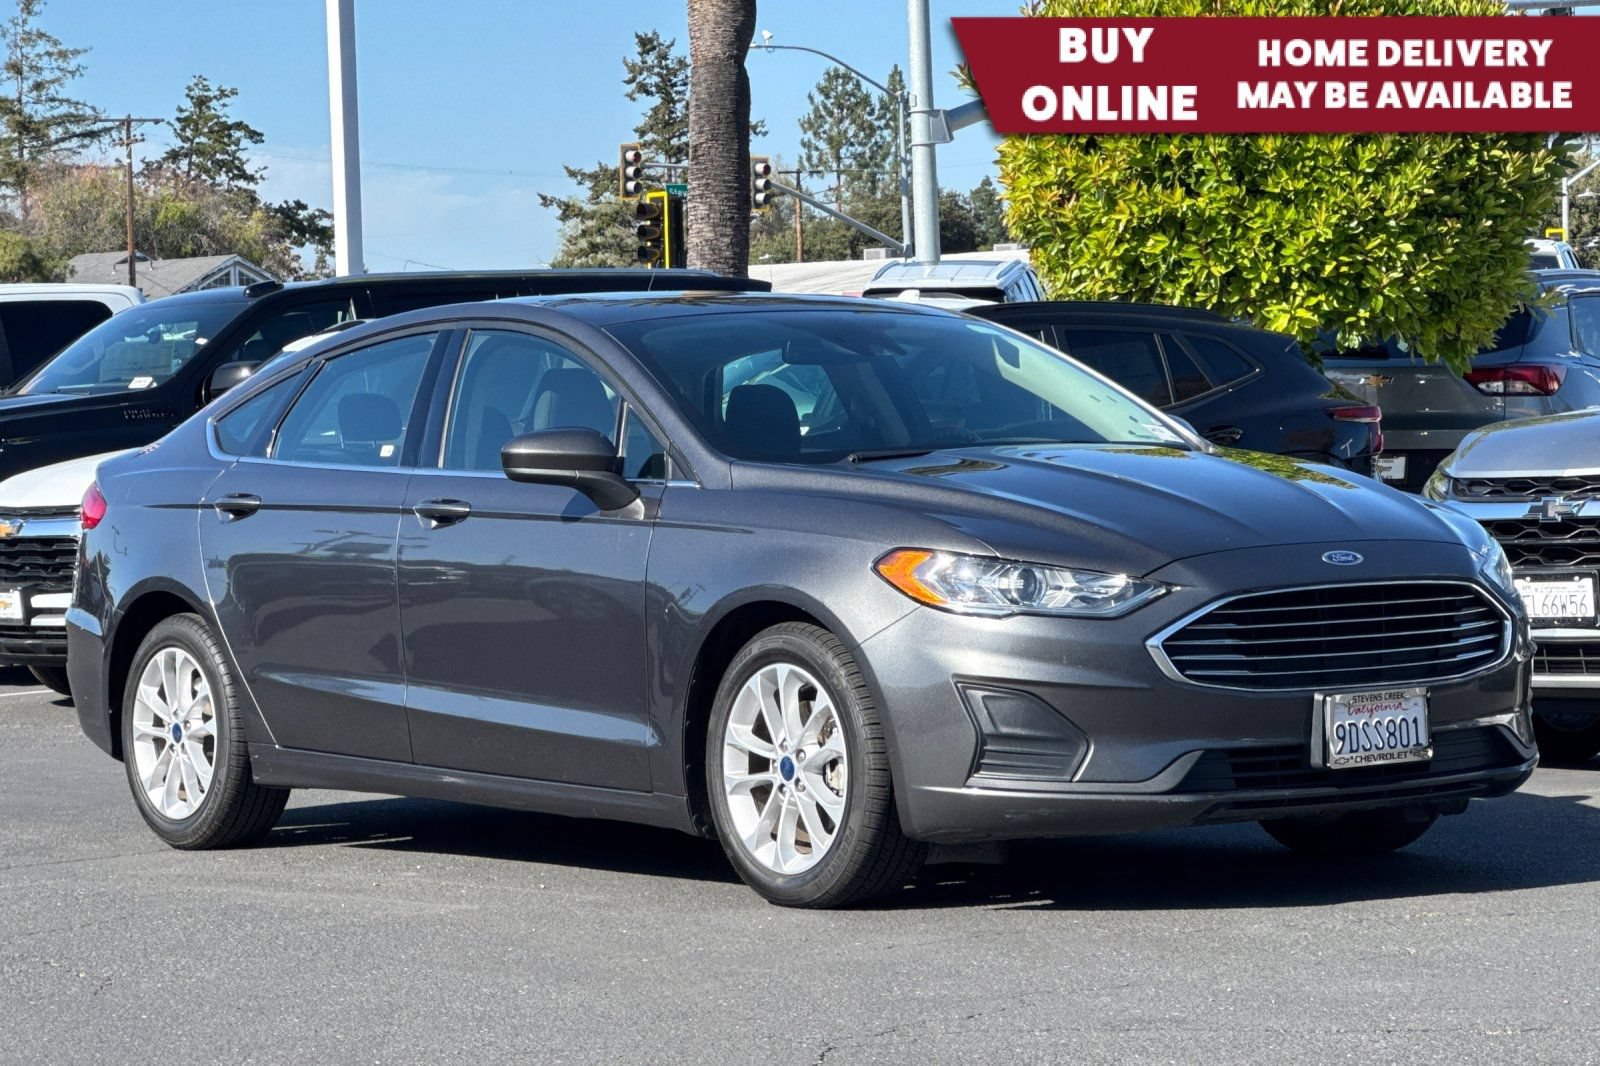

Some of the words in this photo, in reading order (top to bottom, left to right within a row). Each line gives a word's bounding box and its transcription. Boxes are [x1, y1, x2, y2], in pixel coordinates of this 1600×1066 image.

[1352, 693, 1383, 704] STEVENS
[1384, 691, 1406, 701] CREEK
[1347, 702, 1409, 718] California
[1333, 715, 1424, 755] 9DSS801
[1354, 751, 1409, 763] CHEVROLET
